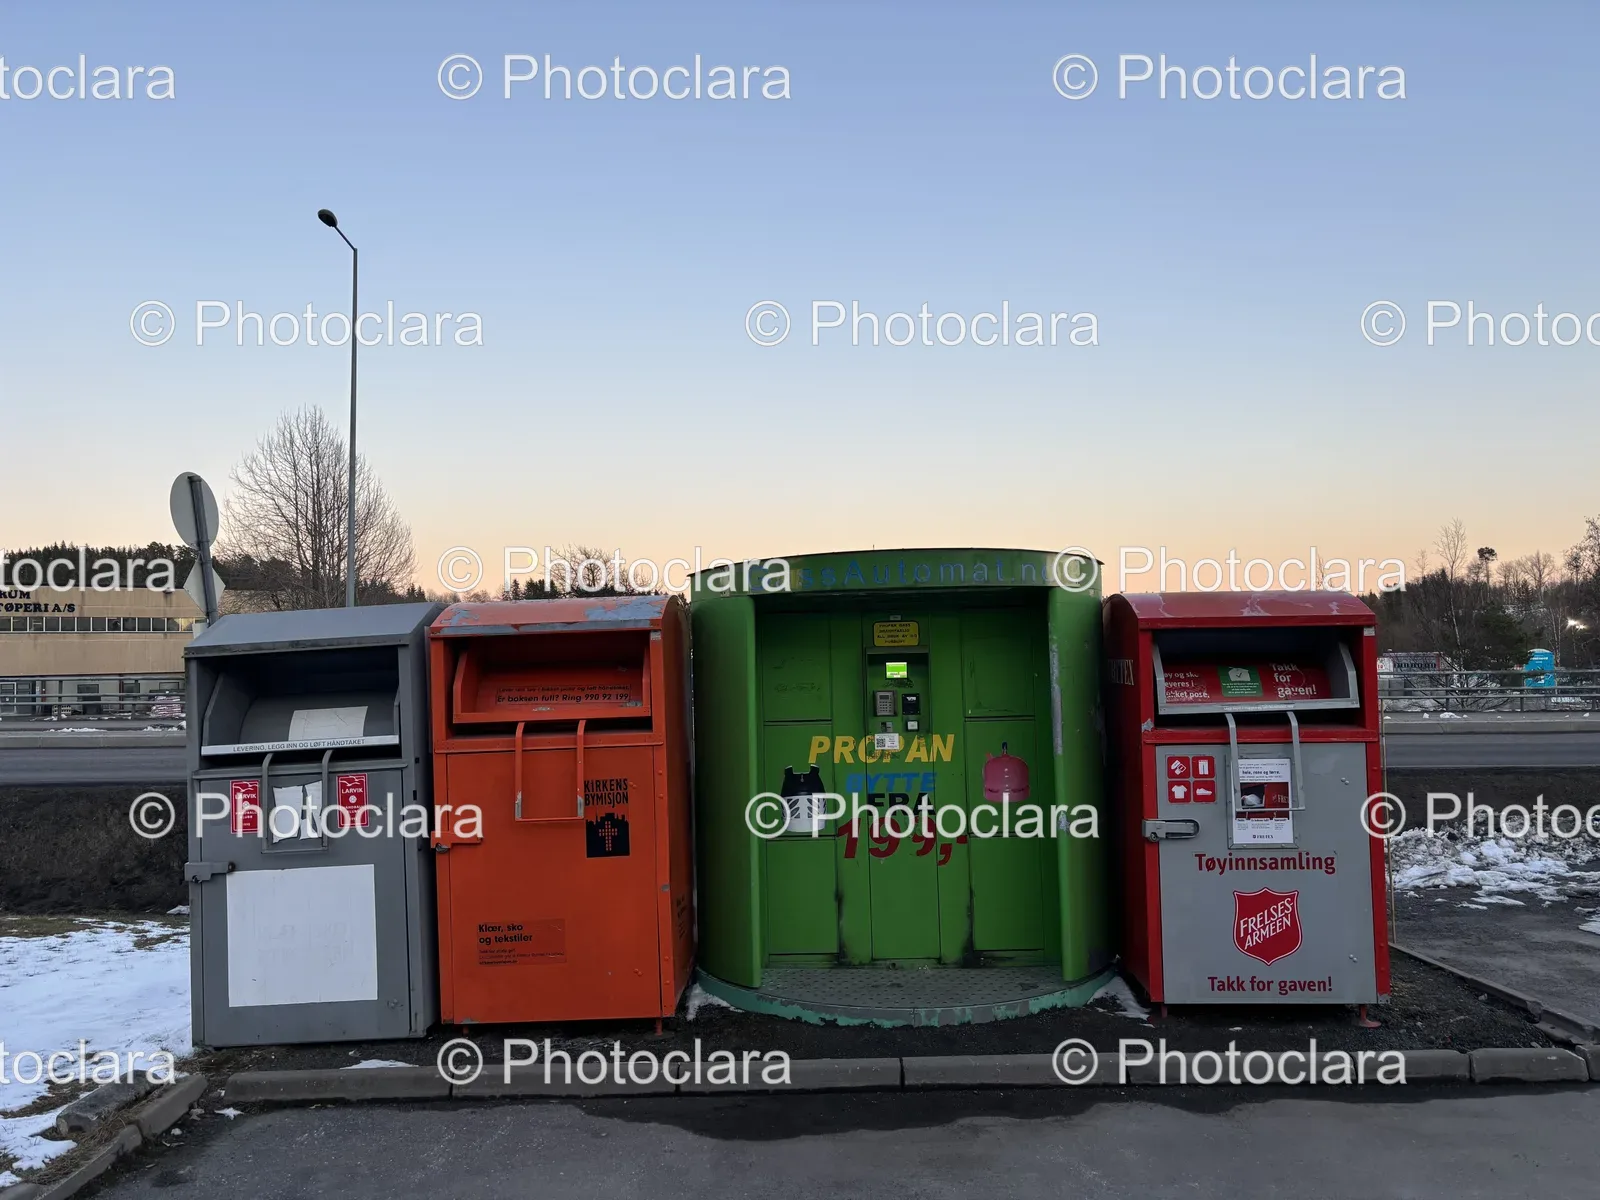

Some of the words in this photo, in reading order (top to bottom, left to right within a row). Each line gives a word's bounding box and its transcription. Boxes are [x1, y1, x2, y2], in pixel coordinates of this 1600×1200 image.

[52, 603, 75, 612] A/S
[1274, 673, 1292, 682] for
[562, 694, 582, 702] Ring
[584, 693, 600, 701] 990
[1277, 684, 1317, 698] gaven!
[326, 739, 365, 747] HÅNDTAKET
[584, 778, 628, 792] KIRKENS
[845, 772, 937, 793] BYTTE
[584, 792, 629, 808] BYMISJON
[1195, 853, 1336, 875] Tøyinnsamling
[1240, 897, 1294, 938] FRELSES-
[478, 923, 504, 933] Klær,
[507, 923, 523, 931] sko
[1244, 914, 1291, 950] ARMEEN
[479, 936, 491, 945] og
[494, 934, 533, 943] tekstiler
[1208, 976, 1245, 992] Takk
[1250, 976, 1274, 992] for
[1278, 976, 1332, 995] gaven!
